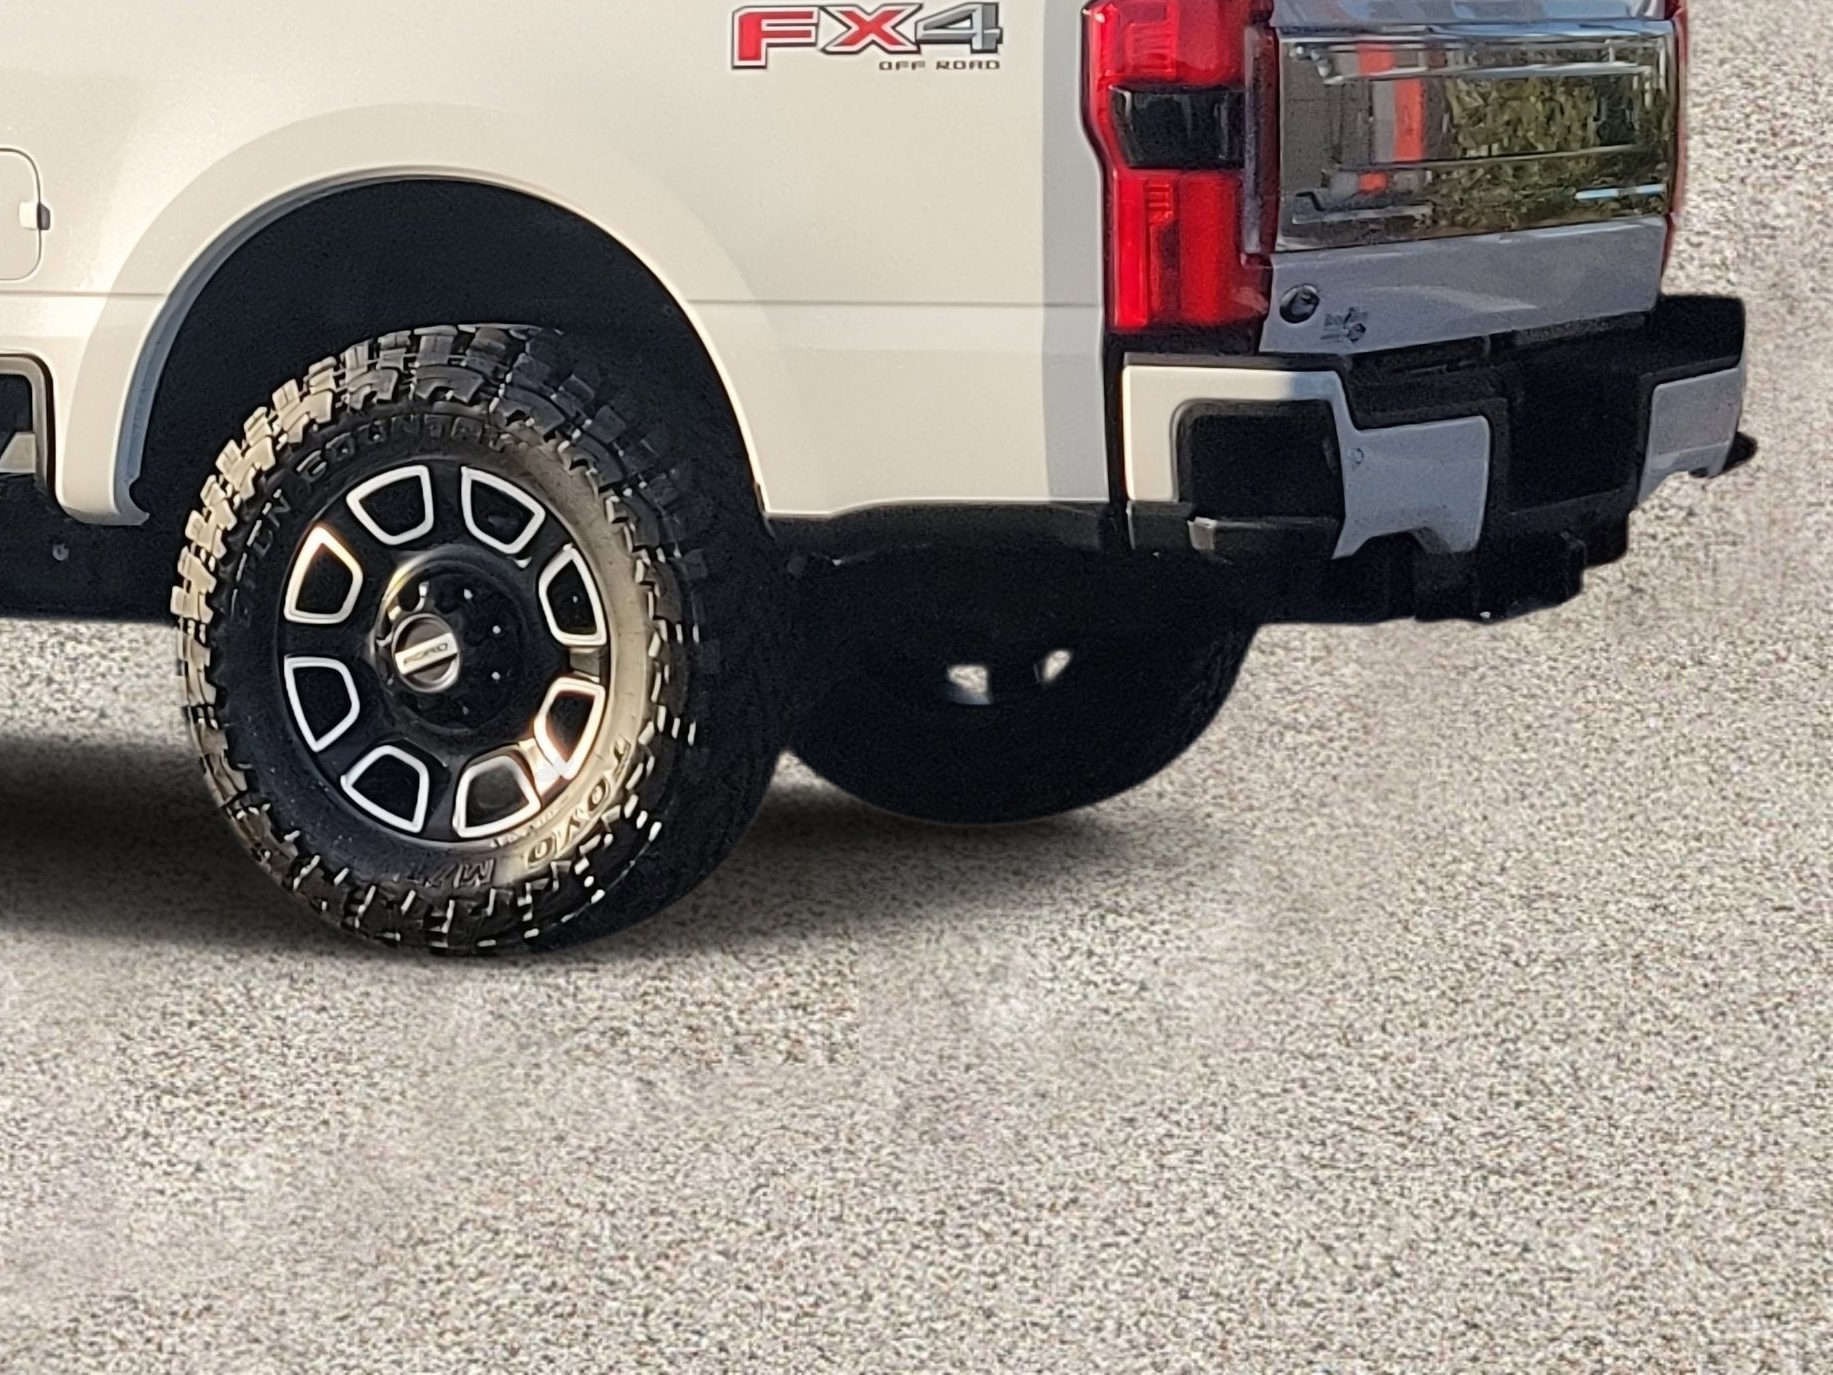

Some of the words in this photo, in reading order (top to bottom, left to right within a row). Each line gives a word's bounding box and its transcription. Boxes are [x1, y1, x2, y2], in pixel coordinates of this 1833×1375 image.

[731, 1, 1003, 70] FX4
[878, 60, 926, 71] OFF
[935, 60, 1001, 71] ROAD
